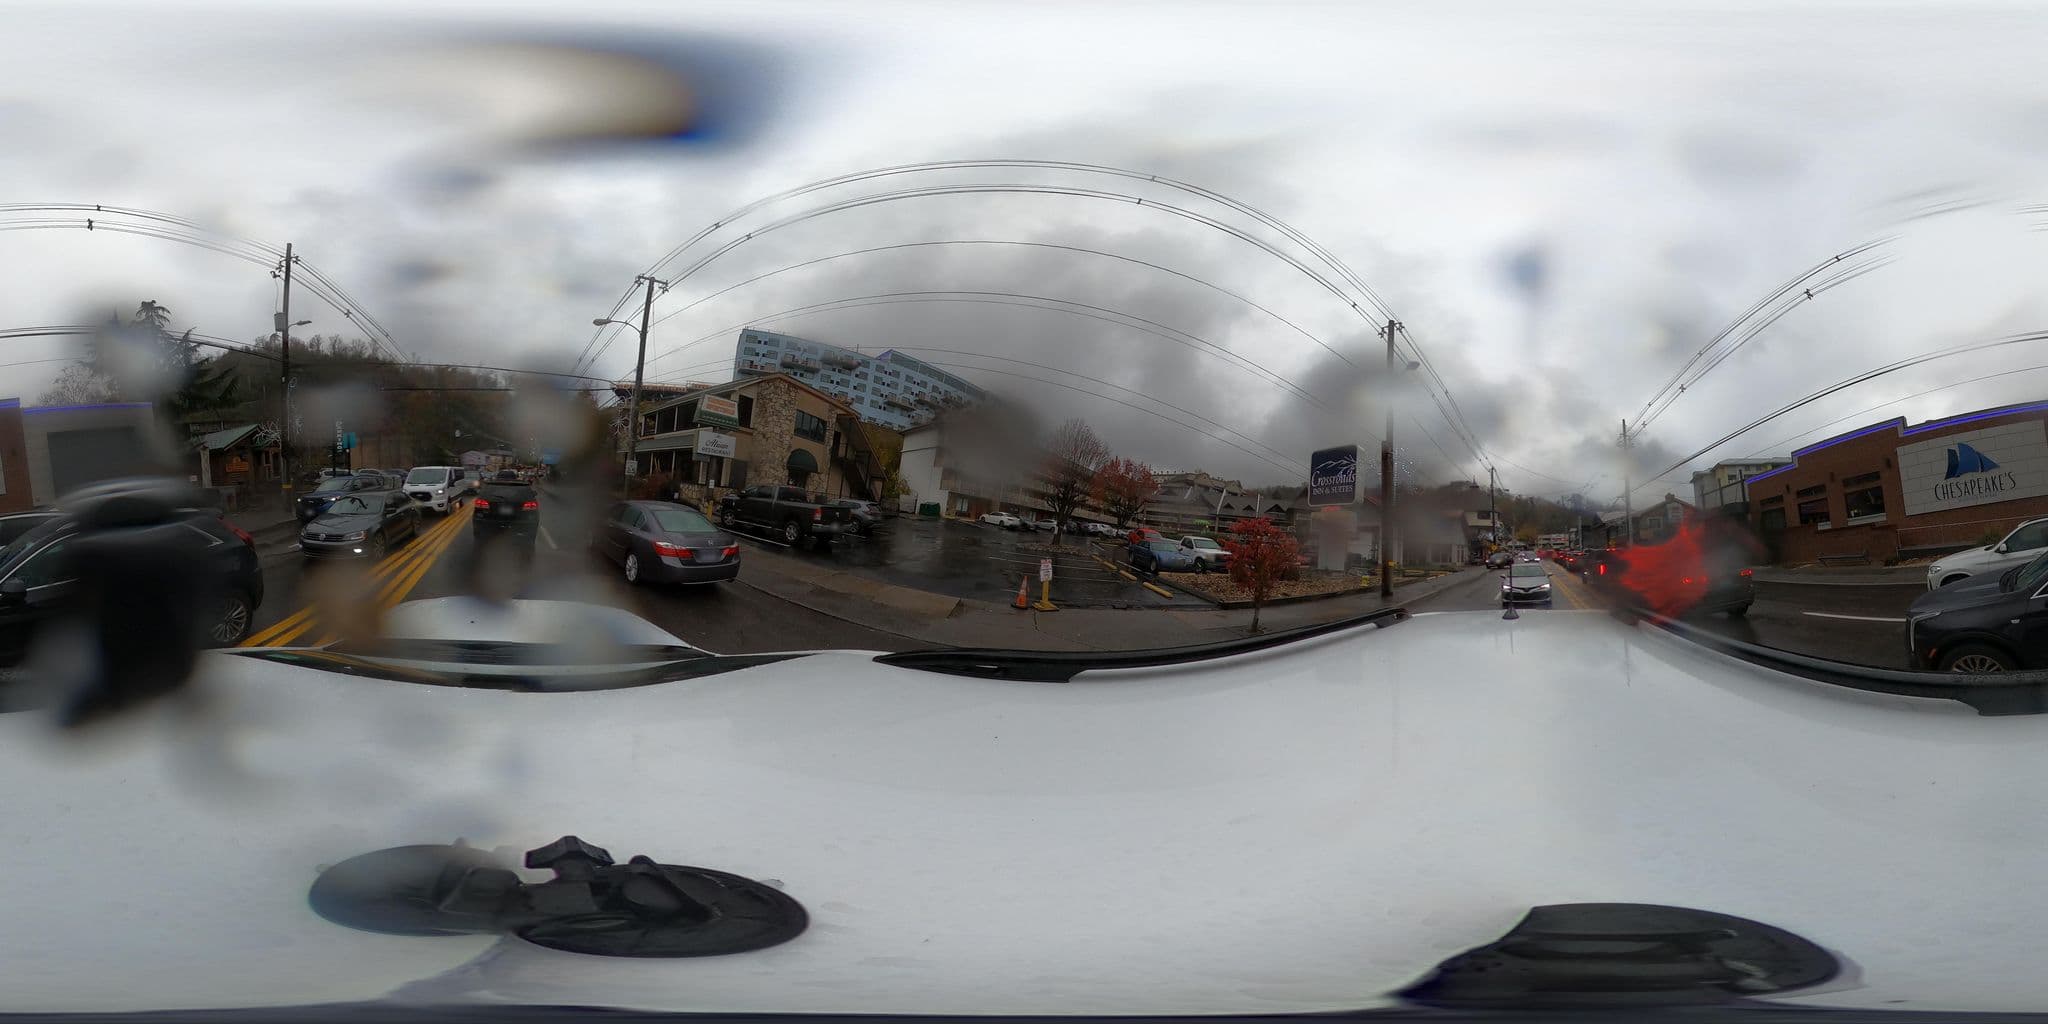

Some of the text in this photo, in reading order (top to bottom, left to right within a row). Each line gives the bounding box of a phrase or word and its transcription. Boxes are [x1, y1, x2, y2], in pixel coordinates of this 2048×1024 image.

[1311, 470, 1355, 487] Crossroads
[1934, 471, 2017, 501] CHESAPEAKE'S
[1331, 485, 1353, 493] SUITES
